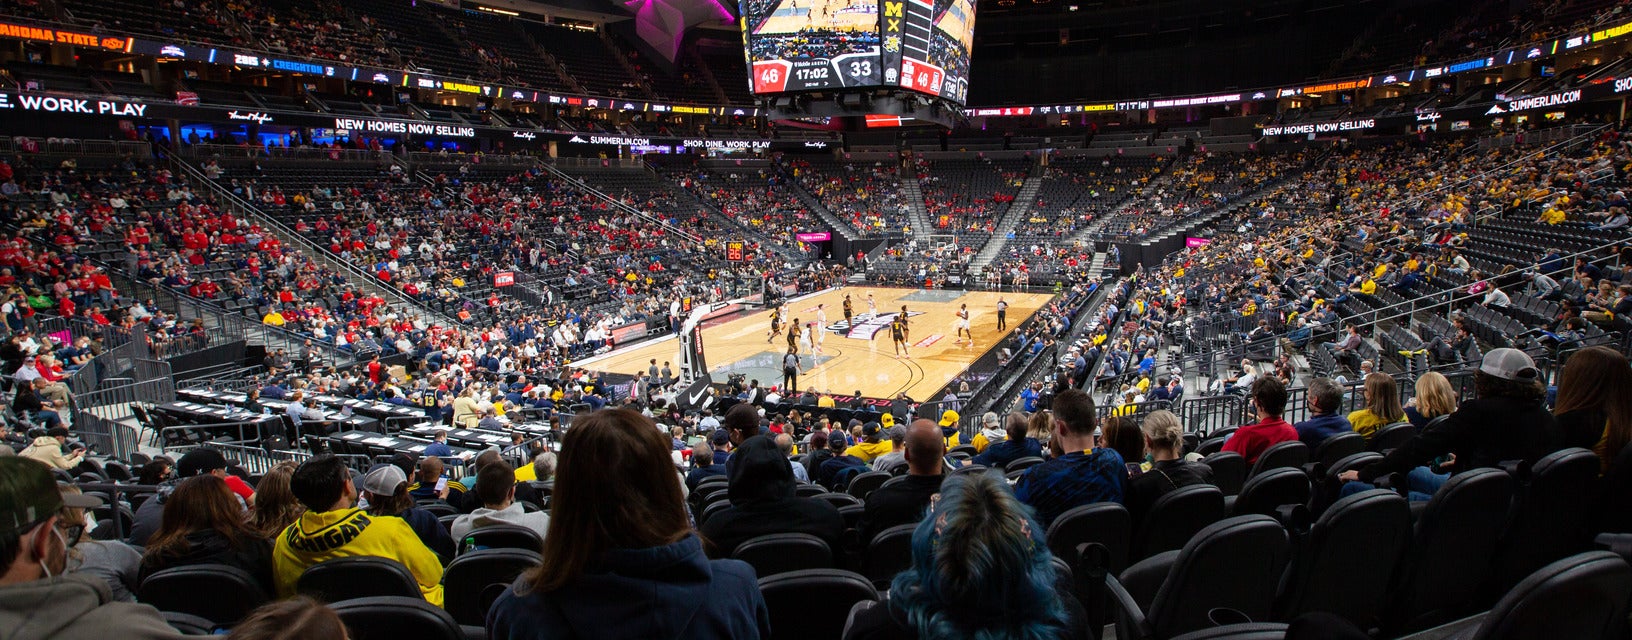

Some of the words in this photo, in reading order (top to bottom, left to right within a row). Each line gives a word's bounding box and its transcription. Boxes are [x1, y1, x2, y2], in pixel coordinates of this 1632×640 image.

[885, 1, 903, 18] M
[56, 31, 99, 47] STATE
[273, 60, 323, 75] CREIGHTON
[796, 67, 829, 80] 17:02
[851, 61, 871, 77] 33
[761, 69, 779, 83] 46
[1337, 81, 1357, 90] STATE
[19, 95, 93, 113] WORK.
[98, 101, 147, 116] PLAY
[1509, 90, 1581, 112] SUMMERLIN.COM
[336, 118, 364, 131] NEW
[367, 121, 407, 133] HOMES
[408, 123, 434, 134] NOW
[436, 125, 474, 137] SELLING
[1263, 128, 1283, 136] NEW
[1283, 125, 1314, 135] HOMES
[1316, 123, 1339, 132] NOW
[1339, 120, 1375, 131] SELLING
[590, 136, 650, 145] SUMMERLIN.COM
[728, 249, 741, 259] 26
[425, 396, 435, 407] 13
